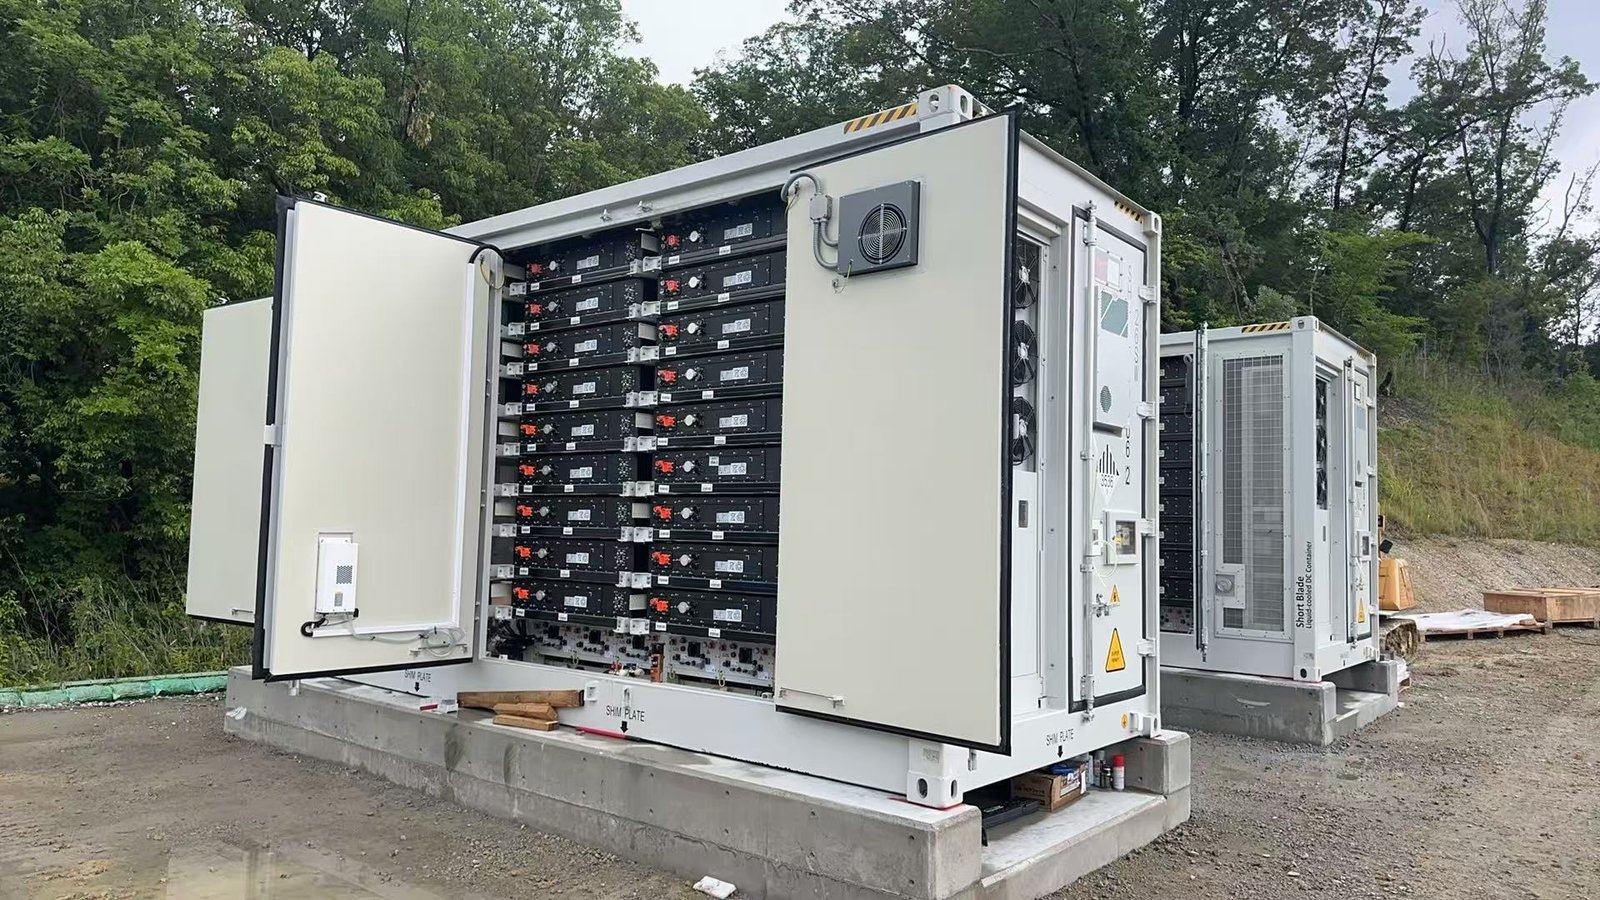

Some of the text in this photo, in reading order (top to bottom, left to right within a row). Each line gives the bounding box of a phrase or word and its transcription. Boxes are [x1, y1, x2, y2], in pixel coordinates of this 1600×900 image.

[1305, 574, 1312, 584] DC
[1295, 576, 1305, 629] Short Blade
[1305, 584, 1313, 629] Liquid-cooled
[605, 705, 645, 722] SHIM PLATE
[1046, 728, 1074, 746] SHIM PLATE
